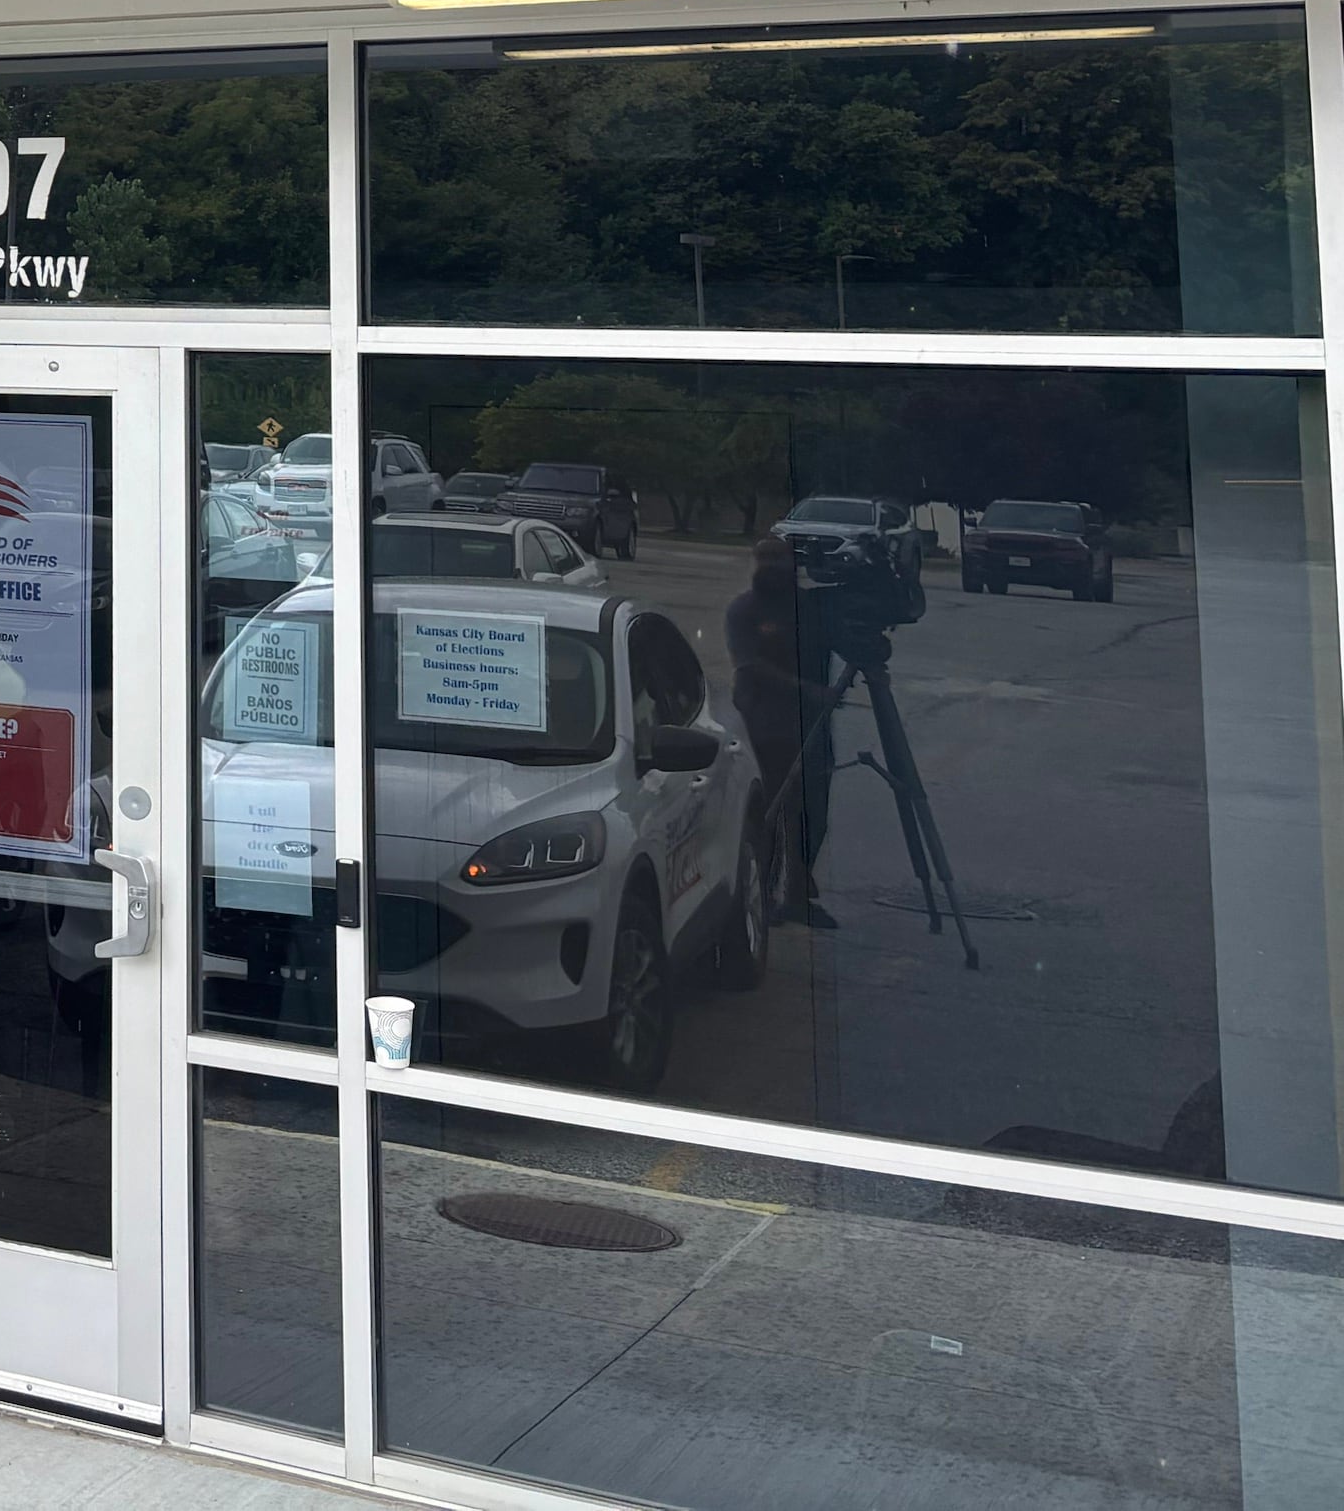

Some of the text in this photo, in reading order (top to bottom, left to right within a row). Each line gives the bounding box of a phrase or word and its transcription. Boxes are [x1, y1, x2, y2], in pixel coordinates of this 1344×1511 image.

[13, 538, 34, 550] OF
[261, 632, 280, 645] NO
[416, 625, 525, 642] Kansas City Board
[246, 645, 296, 660] PUBLIC
[436, 643, 505, 657] of Elections
[242, 658, 299, 676] RESTROOMS
[423, 658, 519, 676] Business hours:
[261, 683, 280, 695] NO
[442, 677, 499, 692] 8am-5pm
[247, 695, 293, 711] BAÑOS
[426, 693, 472, 708] Monday
[482, 697, 520, 713] Friday
[241, 708, 298, 726] PÚBLICO
